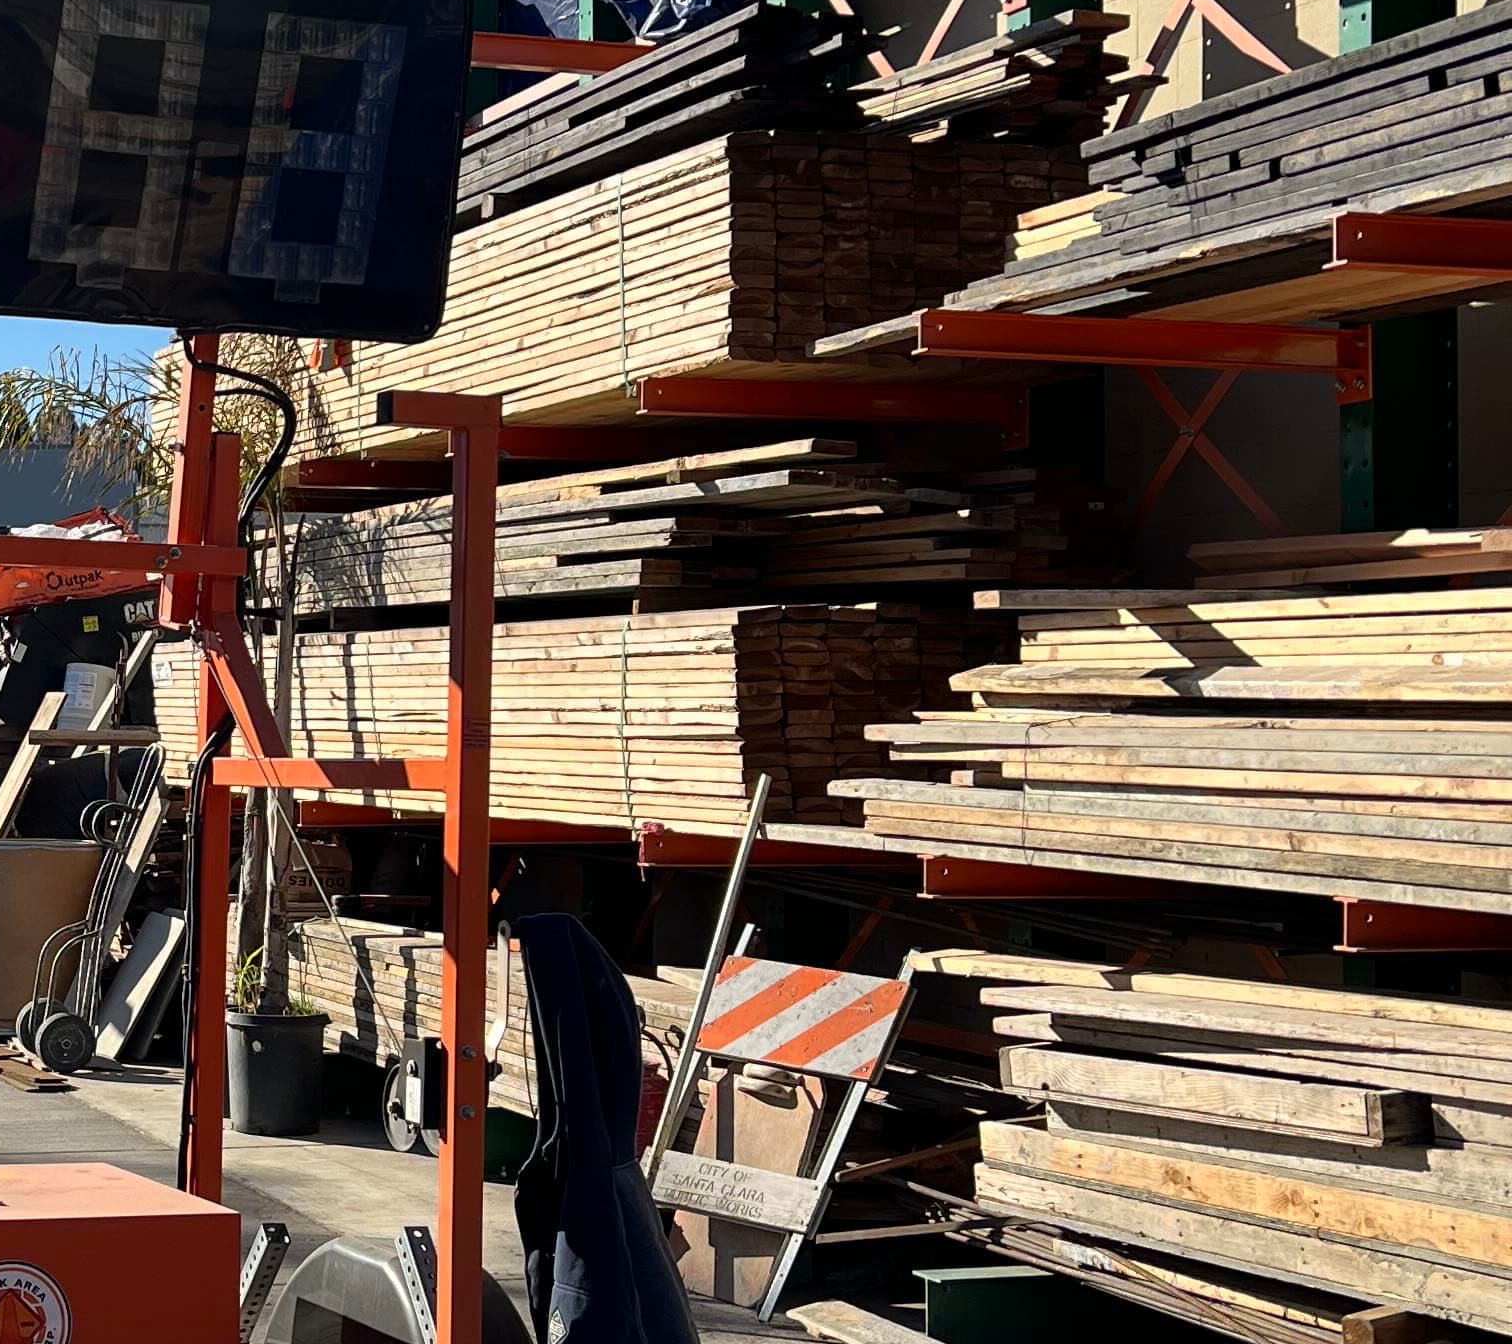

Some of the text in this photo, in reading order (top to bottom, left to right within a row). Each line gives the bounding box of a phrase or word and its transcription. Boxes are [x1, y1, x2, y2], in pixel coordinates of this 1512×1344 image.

[46, 570, 104, 590] Outpak
[123, 600, 155, 624] CAT
[698, 1163, 754, 1183] CITY OF
[672, 1173, 766, 1205] SANTA CLARA
[663, 1187, 764, 1219] PUBLIC WORKS
[13, 1278, 47, 1303] AREA
